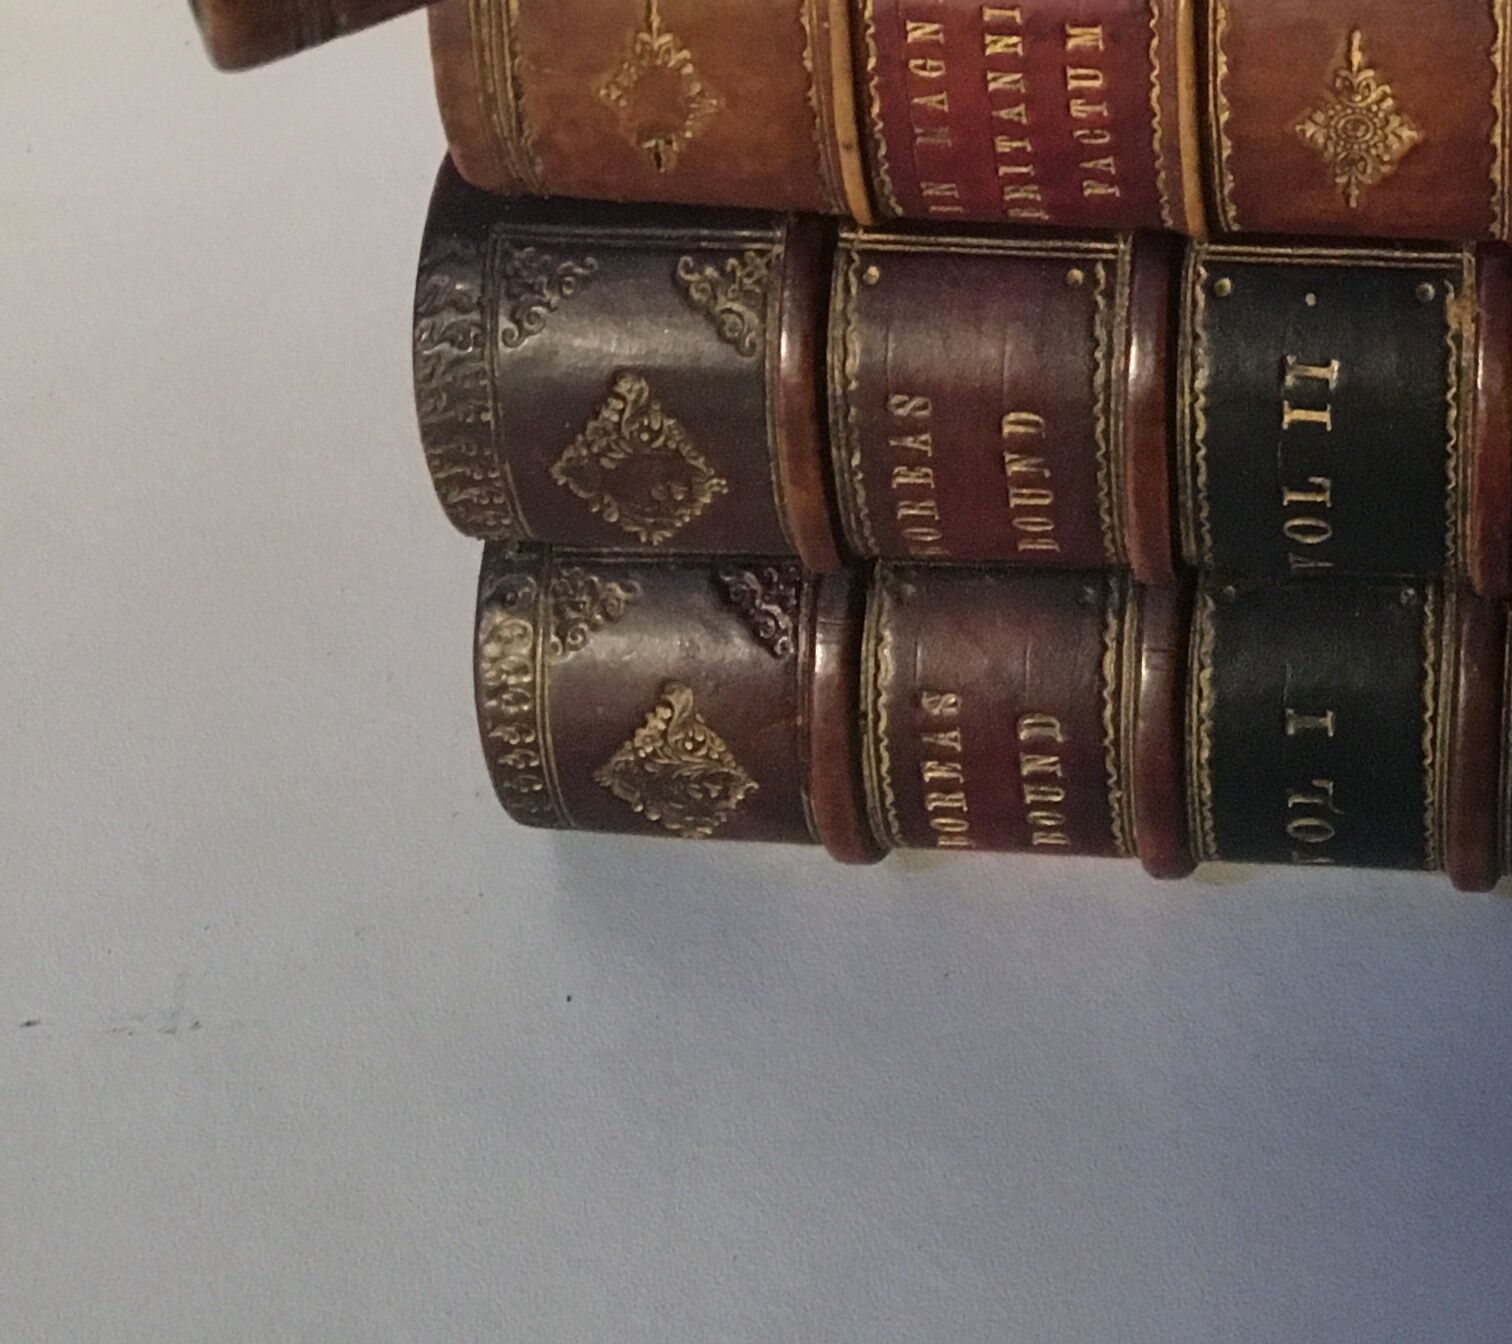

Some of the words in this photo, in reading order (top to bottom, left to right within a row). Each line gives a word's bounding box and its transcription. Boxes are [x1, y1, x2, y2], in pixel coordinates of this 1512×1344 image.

[1063, 22, 1122, 199] FACTUM
[918, 180, 965, 215] IN
[1280, 353, 1341, 433] II
[886, 392, 949, 557] BOREAS
[1000, 409, 1061, 553] BOUND
[1280, 475, 1336, 570] VOL
[920, 689, 975, 849] BOREAS
[1015, 710, 1072, 847] BOUND
[1284, 707, 1336, 738] I
